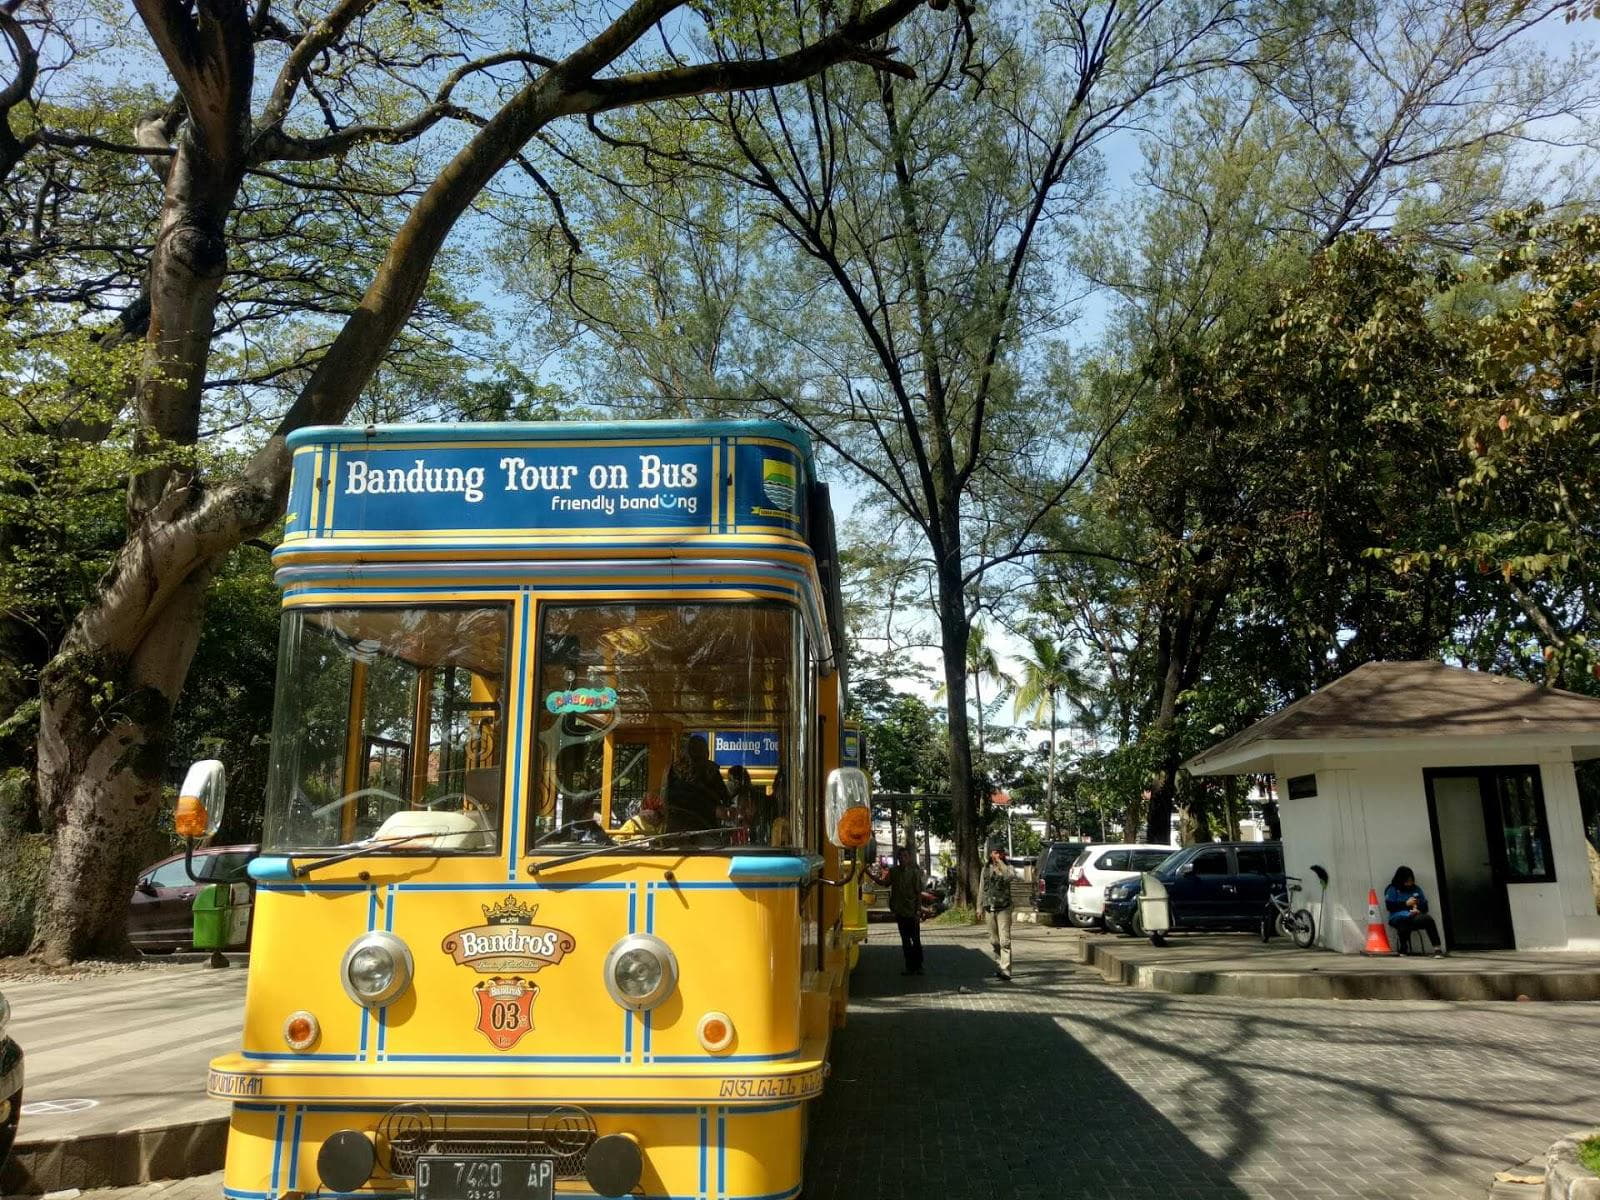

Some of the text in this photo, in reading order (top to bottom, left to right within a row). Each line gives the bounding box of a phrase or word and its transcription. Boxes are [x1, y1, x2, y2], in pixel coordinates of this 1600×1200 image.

[345, 454, 698, 503] Bandung Tour on Bus
[715, 737, 761, 755] Bandung
[492, 1001, 521, 1031] 03
[418, 1162, 431, 1187] D
[527, 1161, 551, 1188] AP
